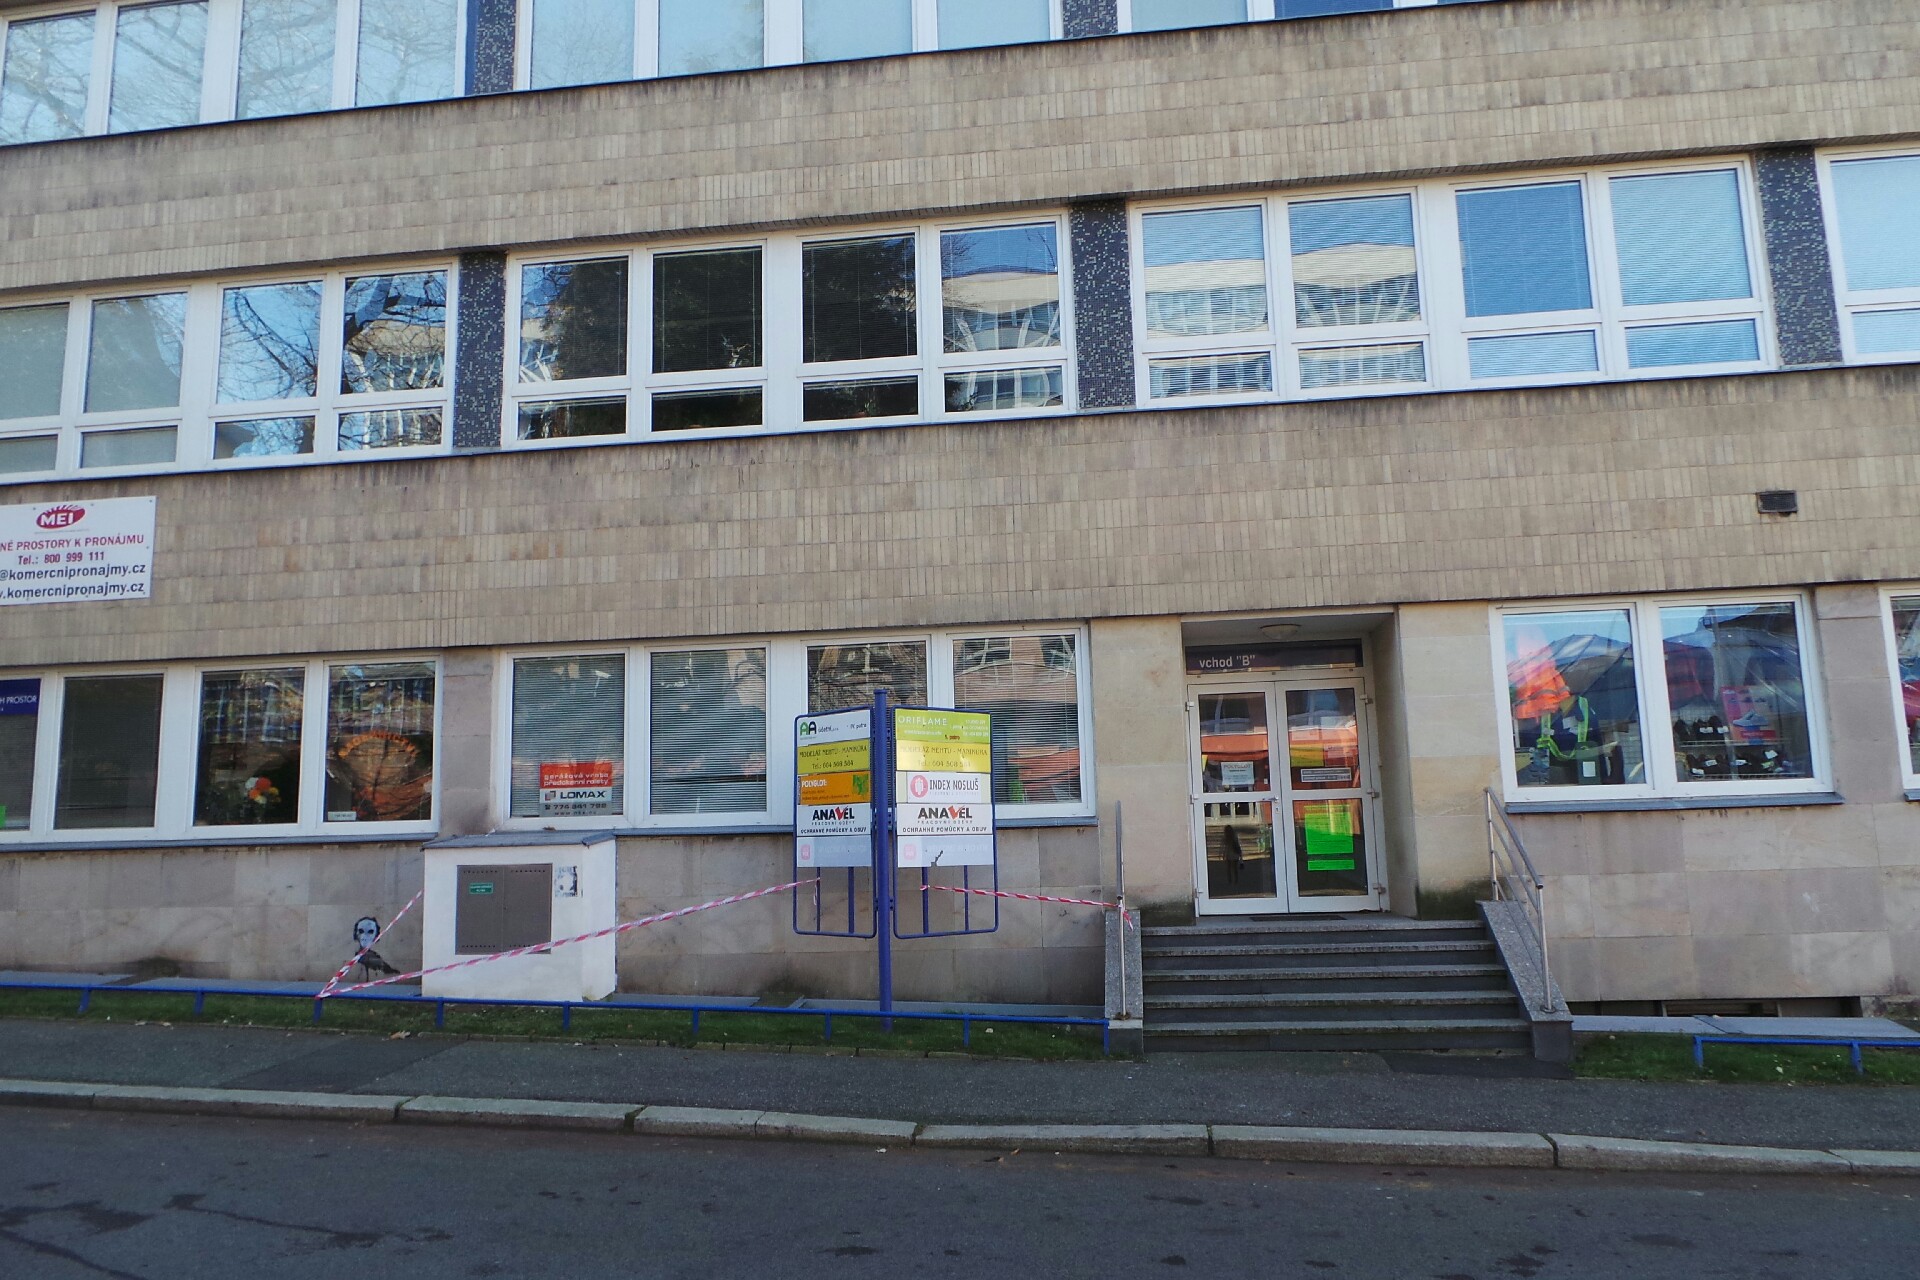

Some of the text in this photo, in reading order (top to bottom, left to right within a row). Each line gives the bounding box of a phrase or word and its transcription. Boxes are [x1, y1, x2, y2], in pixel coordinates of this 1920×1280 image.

[40, 512, 74, 526] MEI
[16, 538, 71, 551] PROSTORY
[75, 538, 81, 547] K
[84, 533, 144, 547] PRONÁJMU
[18, 551, 105, 565] Tel.: 800 999 111
[1199, 654, 1256, 668] vchod "B"
[6, 695, 37, 704] PROSTOR
[897, 715, 948, 726] ORIFLAME
[929, 778, 979, 791] INDEX NOSLUŠ
[560, 790, 607, 799] LOMAX
[812, 806, 855, 821] ANAVEL
[917, 805, 973, 820] ANAVEL
